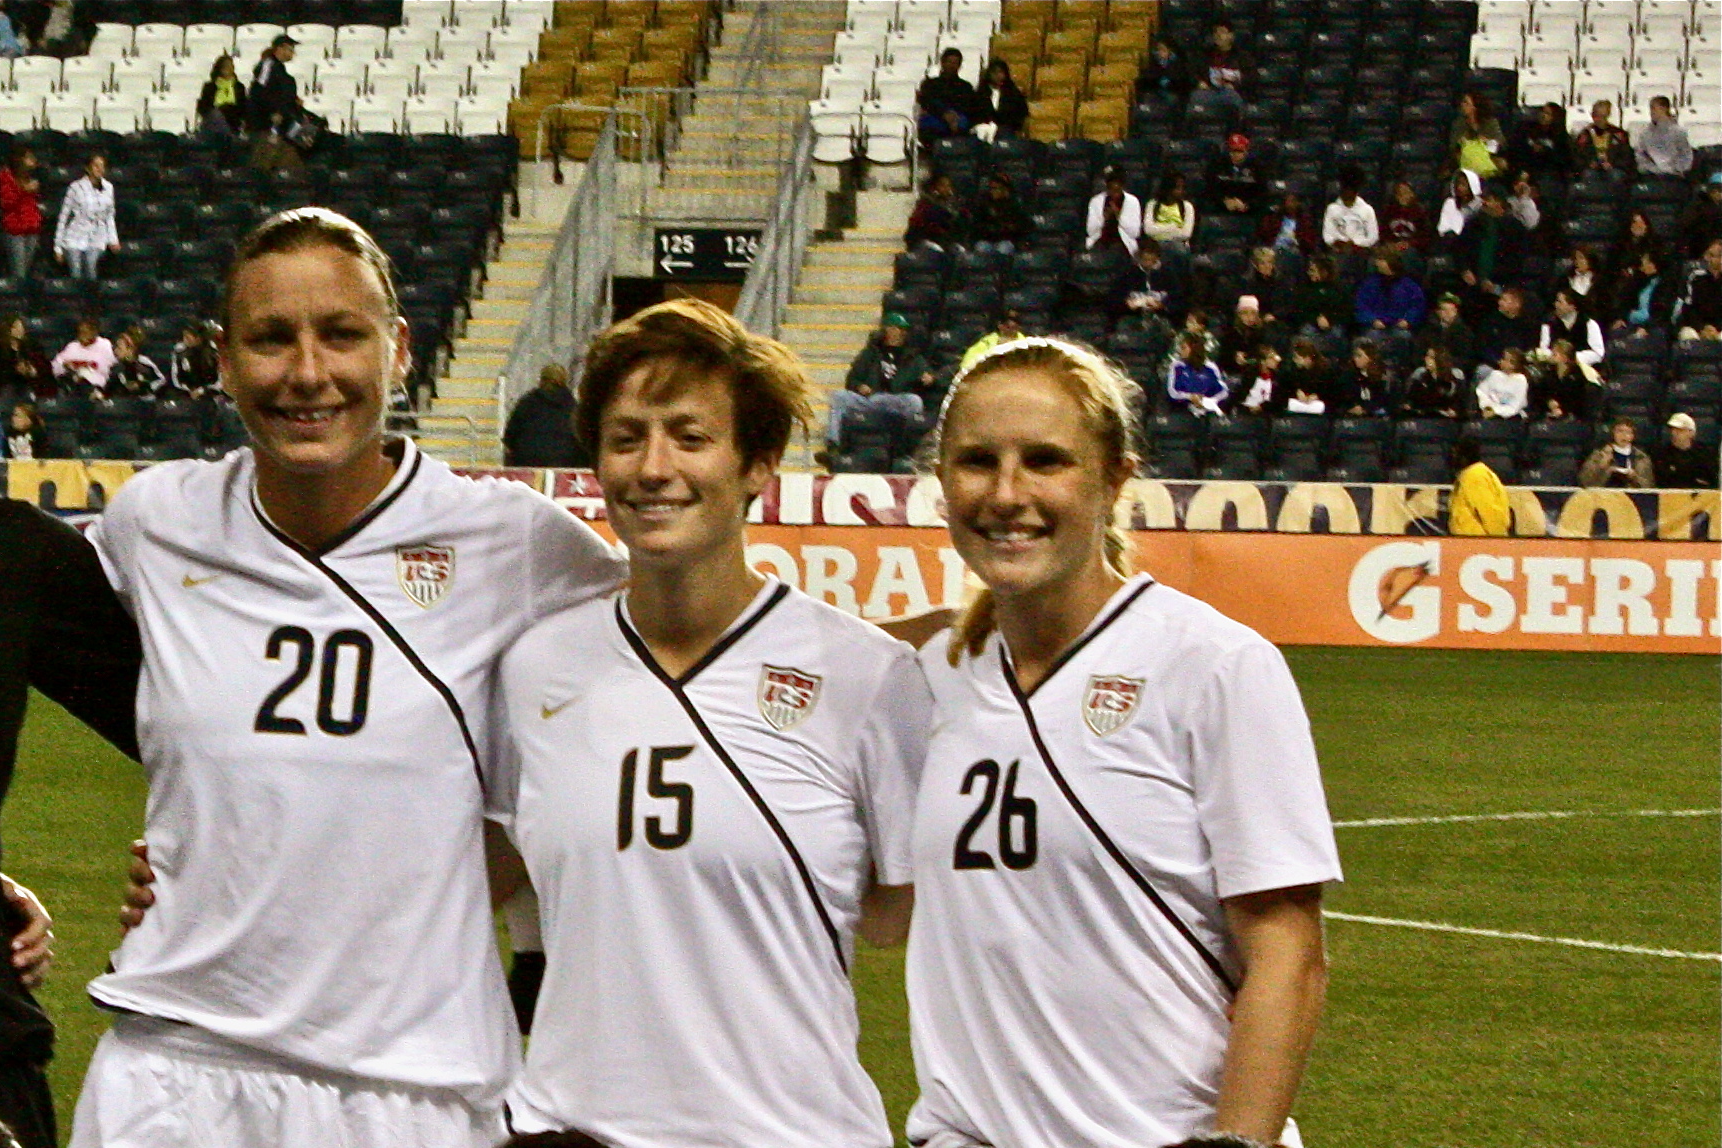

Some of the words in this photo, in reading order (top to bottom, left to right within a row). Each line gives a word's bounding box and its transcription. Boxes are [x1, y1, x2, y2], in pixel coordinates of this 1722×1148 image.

[660, 234, 695, 255] 125
[1458, 556, 1722, 638] SERI
[253, 626, 374, 737] 20
[616, 746, 694, 852] 15
[953, 760, 1037, 871] 26
